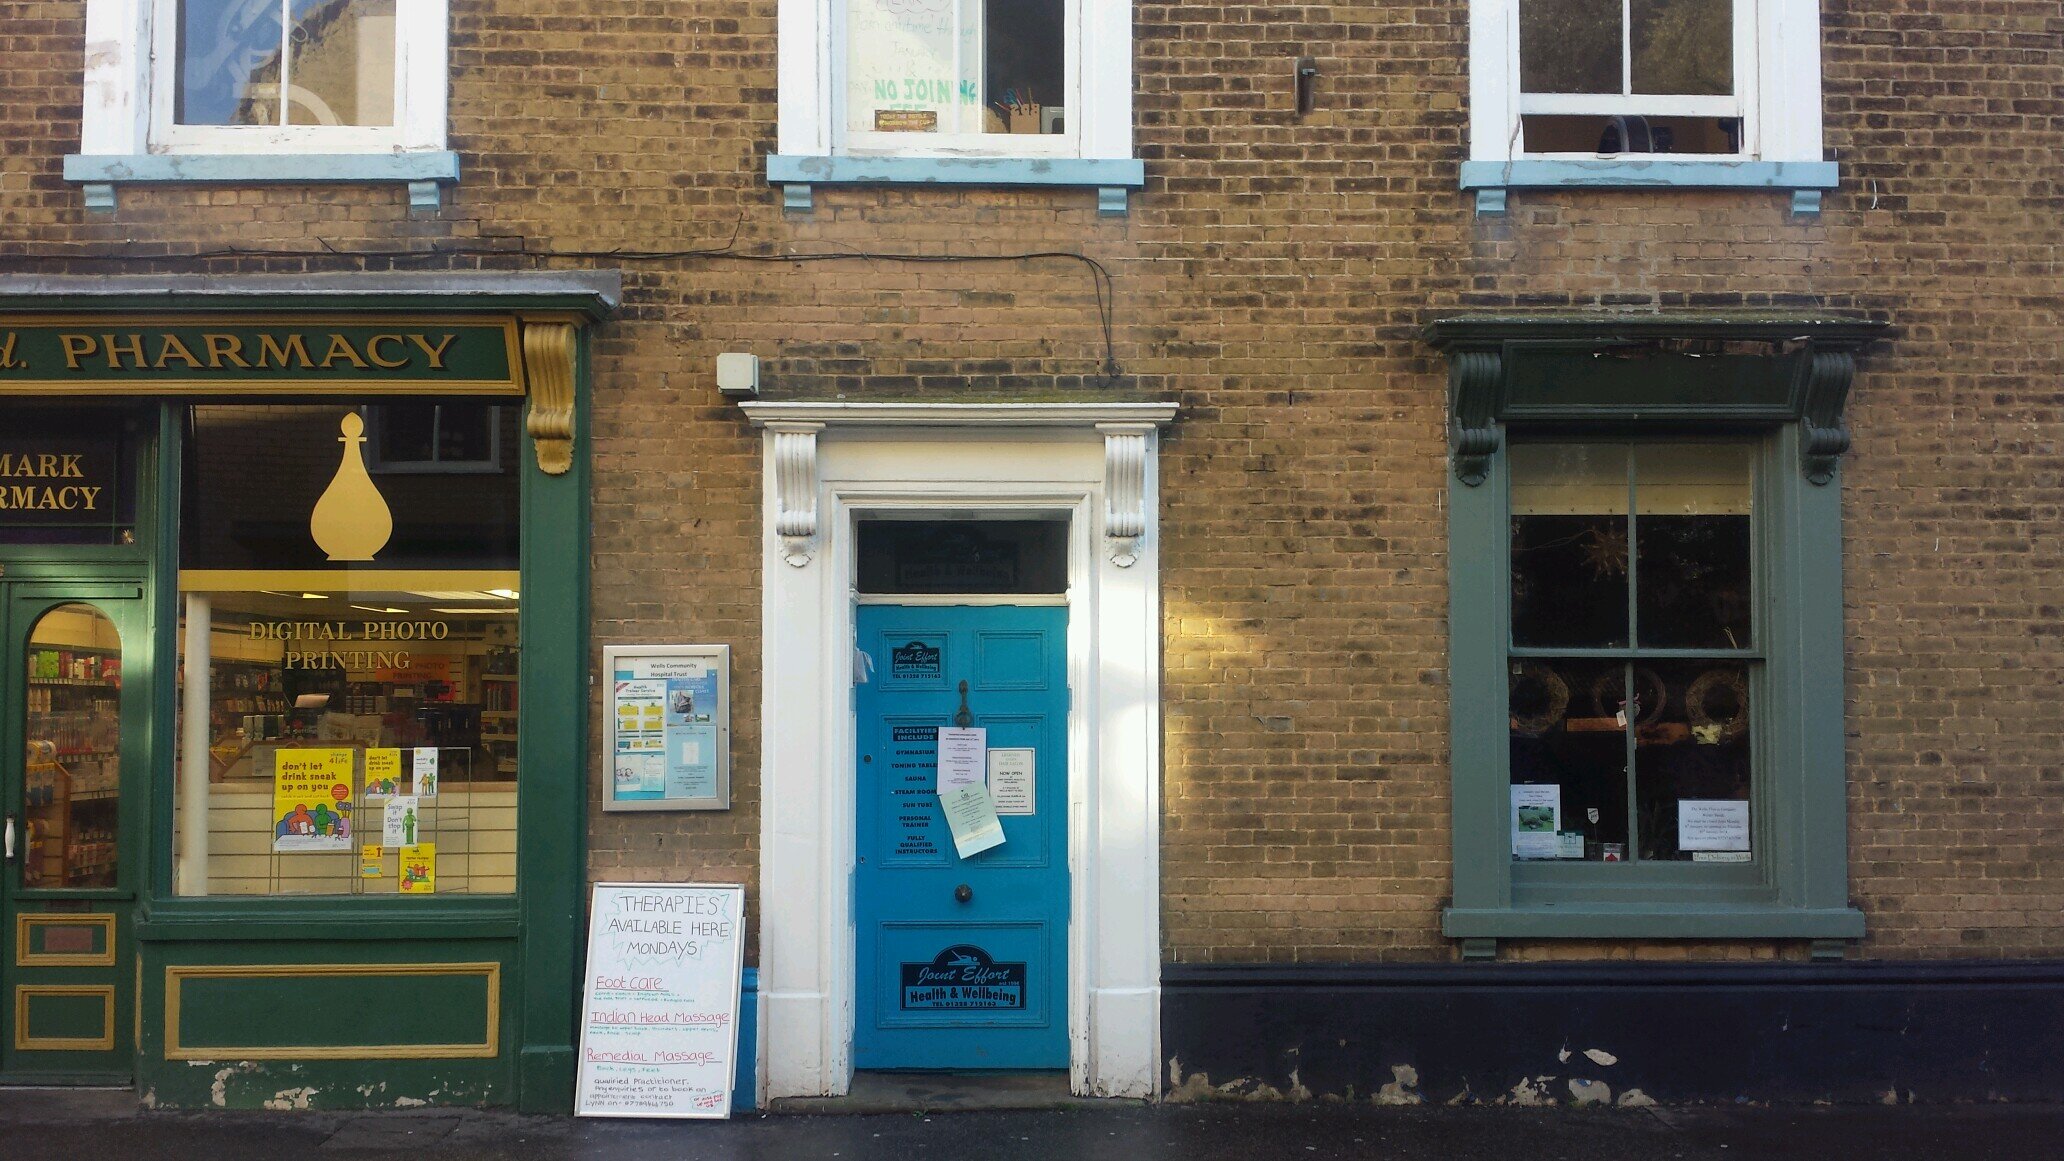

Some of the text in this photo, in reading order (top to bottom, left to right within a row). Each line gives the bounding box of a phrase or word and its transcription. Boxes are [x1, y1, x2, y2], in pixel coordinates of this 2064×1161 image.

[875, 79, 976, 105] NO JOINNG
[58, 334, 458, 370] PHARMACY
[249, 621, 449, 641] DIGITAL PHOTO
[284, 651, 411, 670] PRINTING
[895, 651, 938, 664] Joint Effort
[282, 761, 323, 770] don't let
[282, 772, 336, 780] drink sneak
[282, 784, 294, 793] up
[311, 784, 329, 792] you
[619, 895, 720, 916] THERAPIES
[608, 918, 730, 938] AVAILABLE HERE
[626, 940, 698, 960] MONDAYS
[596, 975, 627, 990] Foot
[918, 966, 1010, 985] Joint Effort
[910, 987, 1016, 1006] Health & Wellbeing
[591, 1008, 730, 1029] Indian Head Massage
[587, 1047, 715, 1067] Remedial Massage
